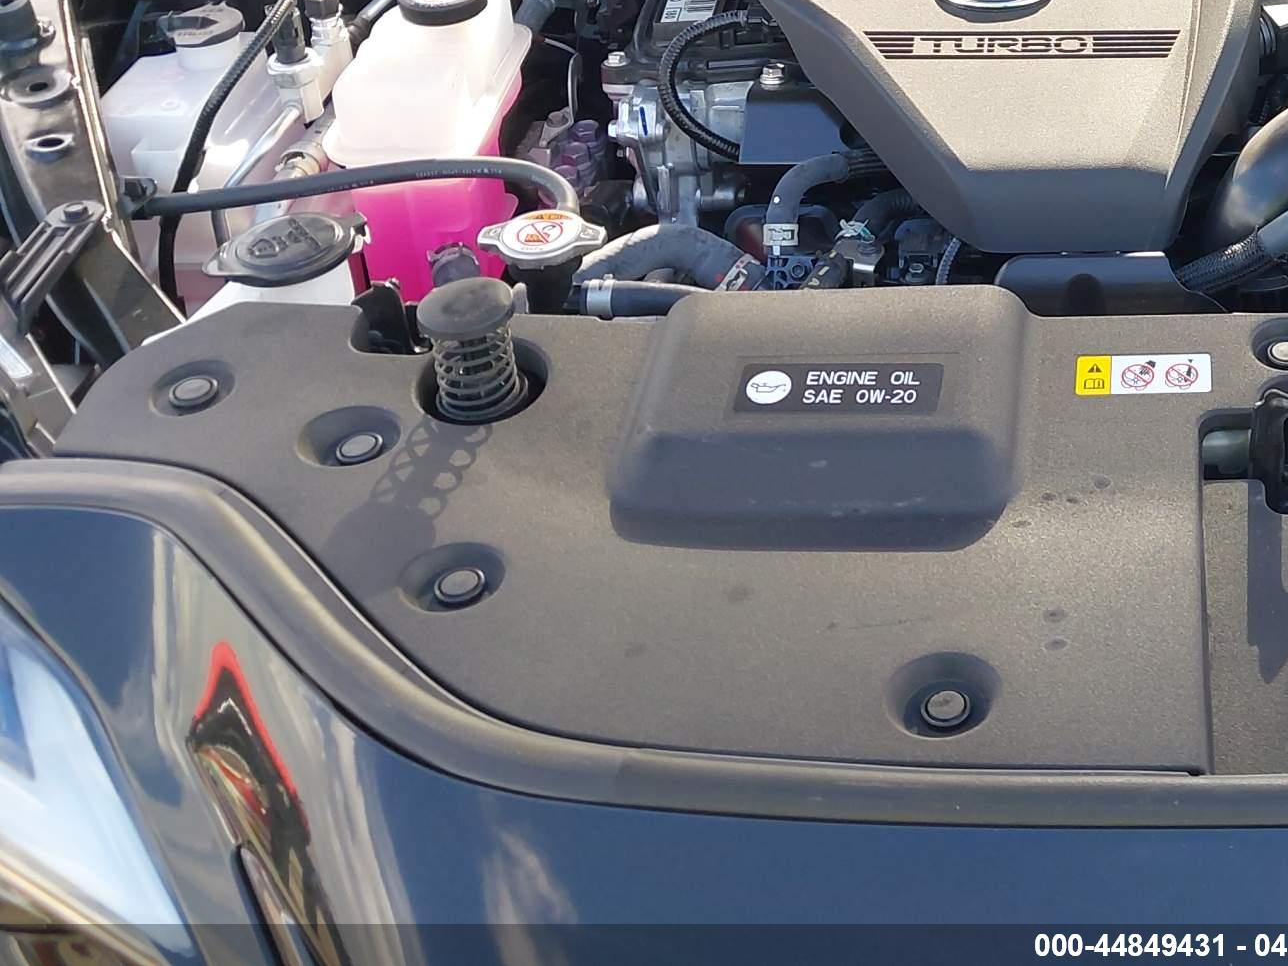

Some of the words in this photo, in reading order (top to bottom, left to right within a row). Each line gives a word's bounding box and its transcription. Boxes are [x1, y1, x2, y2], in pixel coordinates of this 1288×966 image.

[919, 36, 1088, 53] TURBO
[807, 371, 878, 385] ENGINE
[891, 372, 920, 385] OIL
[803, 390, 843, 403] SAE
